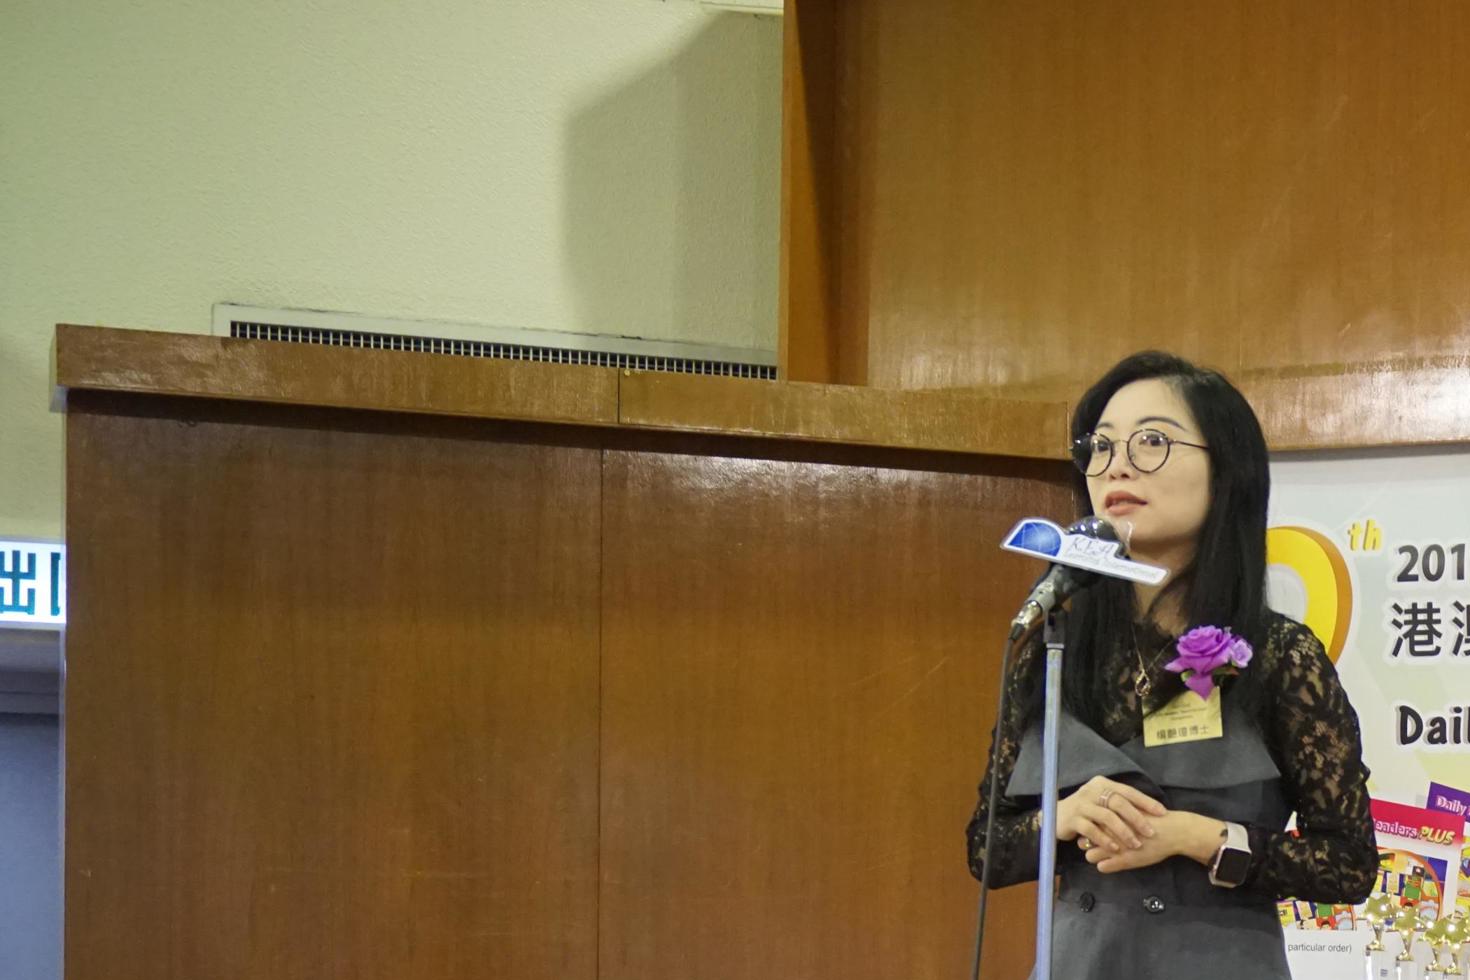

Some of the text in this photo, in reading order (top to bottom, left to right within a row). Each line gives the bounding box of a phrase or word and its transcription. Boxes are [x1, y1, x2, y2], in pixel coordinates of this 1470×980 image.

[0, 550, 61, 616] 出
[1436, 795, 1467, 816] Daily
[1374, 819, 1455, 846] eaders PLUS
[1288, 943, 1352, 954] particular order)
